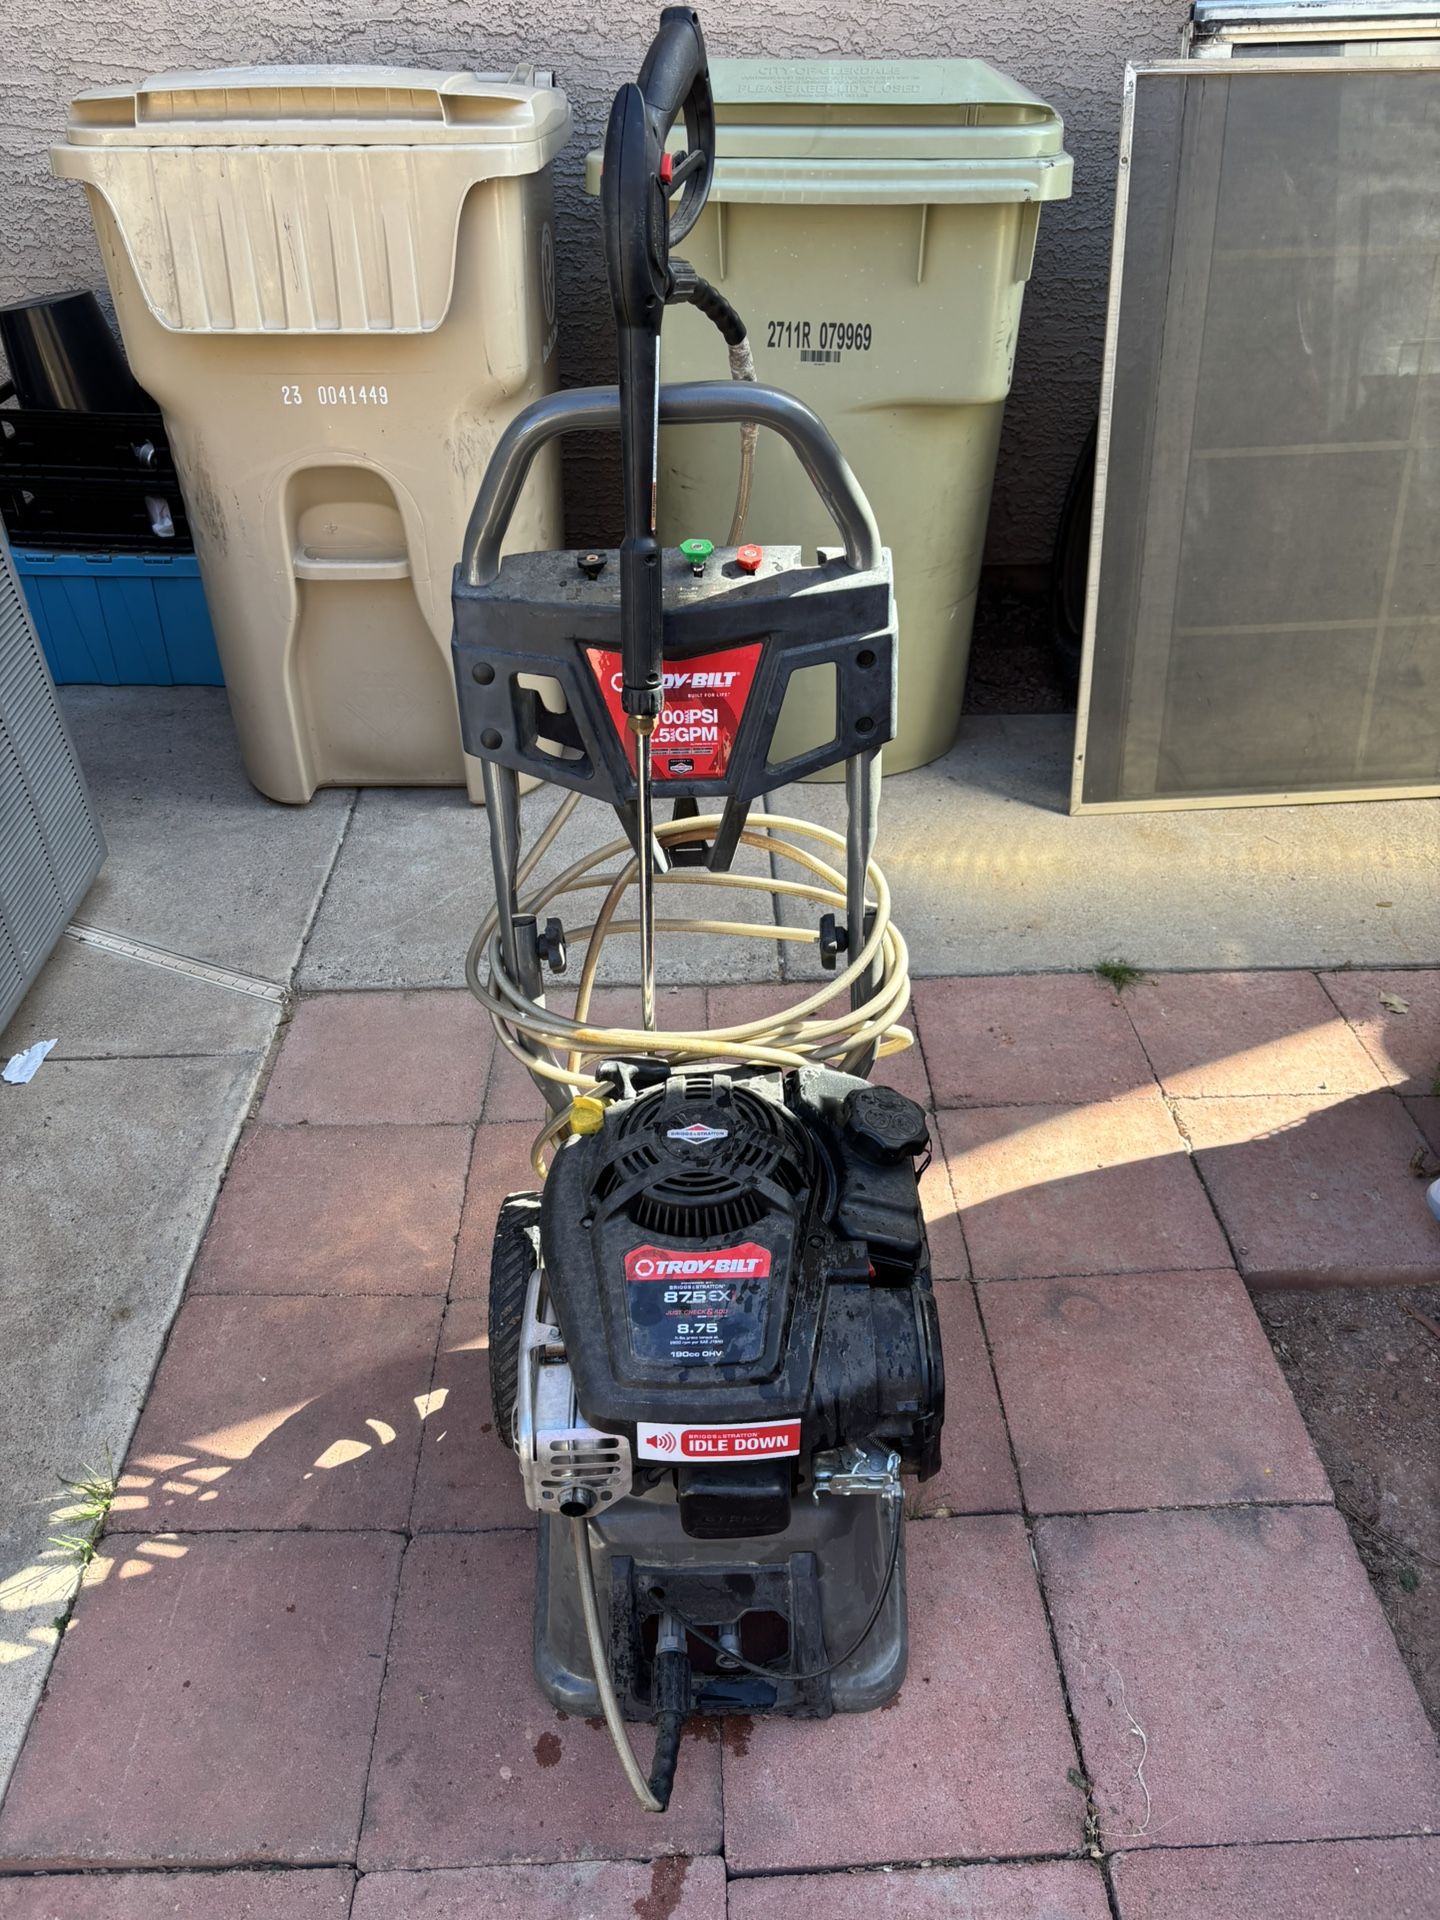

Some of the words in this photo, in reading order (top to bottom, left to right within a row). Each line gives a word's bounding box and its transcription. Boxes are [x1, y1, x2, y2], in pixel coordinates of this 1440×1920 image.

[758, 66, 792, 76] CITY
[795, 66, 816, 76] OF
[819, 66, 900, 76] GLENDALE
[738, 84, 793, 94] PLEASE
[796, 84, 833, 94] KEEP
[863, 84, 920, 94] CLOSED
[767, 321, 811, 349] 2711R
[819, 322, 872, 351] 079969
[281, 385, 303, 405] 23
[318, 385, 389, 405] 0041449
[690, 709, 718, 724] PSI
[651, 728, 670, 743] .5
[675, 726, 718, 743] GPM
[656, 1258, 759, 1275] TROY-BILT
[677, 1323, 718, 1334] 8.75
[689, 1439, 729, 1452] IDLE
[734, 1434, 789, 1451] DOWN
